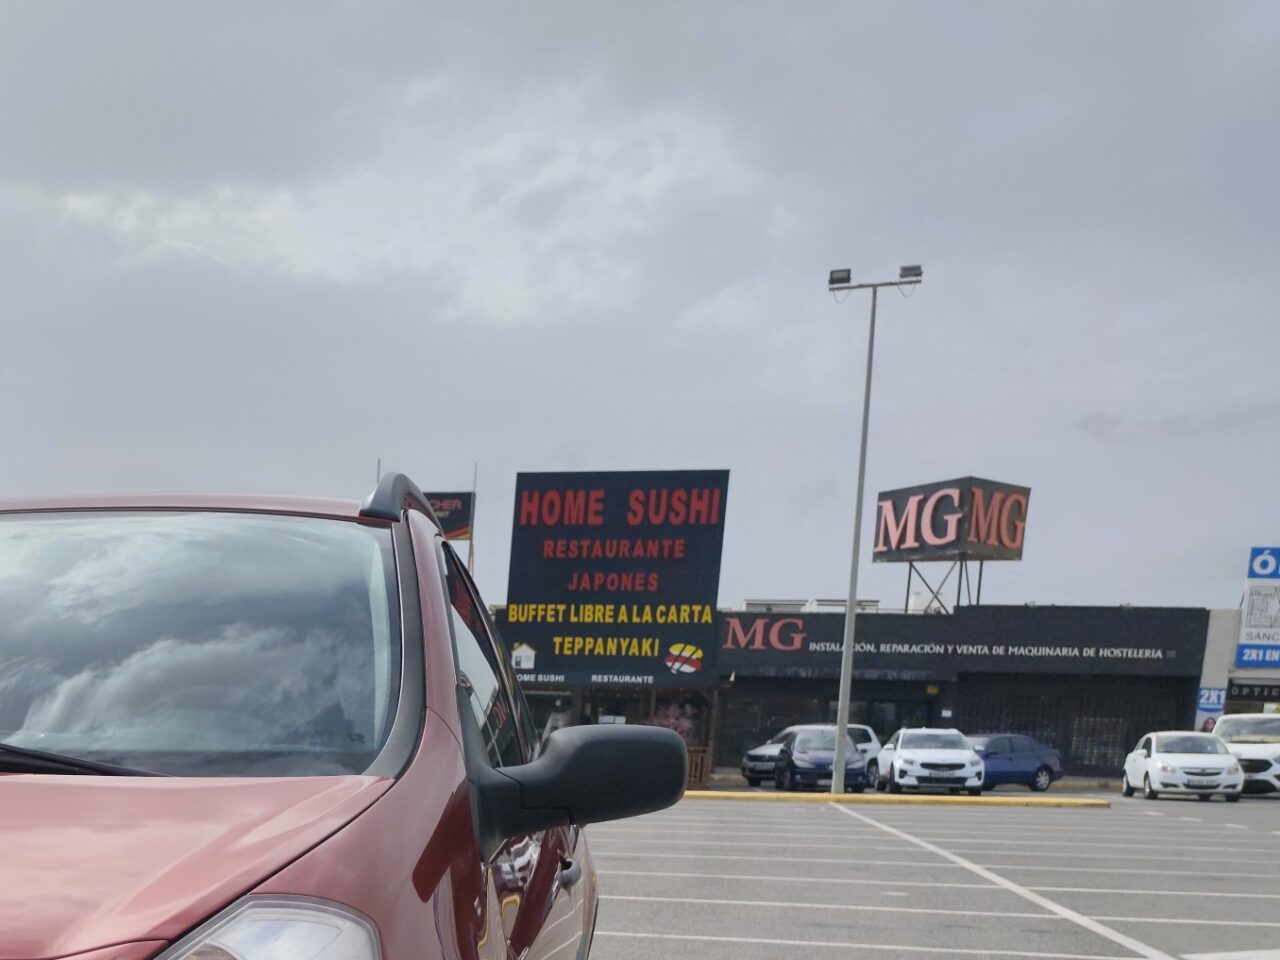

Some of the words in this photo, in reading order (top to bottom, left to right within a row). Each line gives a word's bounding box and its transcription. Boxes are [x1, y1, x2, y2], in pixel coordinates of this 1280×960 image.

[520, 490, 605, 526] HOME
[627, 488, 721, 526] SUSHI
[874, 488, 963, 552] MG
[967, 487, 1026, 549] MG
[543, 539, 686, 558] RESTAURANTE
[567, 572, 659, 591] JAPONES
[508, 604, 566, 623] BUFFET
[570, 604, 614, 623] LIBRE
[618, 605, 628, 623] A
[632, 605, 652, 624] LA
[656, 605, 713, 624] CARTA
[722, 617, 807, 651] MG
[553, 637, 660, 656] TEPPANYAKI
[947, 645, 954, 654] Y
[956, 645, 989, 655] VENTA
[992, 645, 1005, 655] DE
[1008, 646, 1079, 657] MAQUINARIA
[1082, 648, 1096, 657] DE
[517, 674, 536, 682] OME
[537, 674, 565, 682] SUSHI
[591, 675, 654, 684] RESTAURANTE
